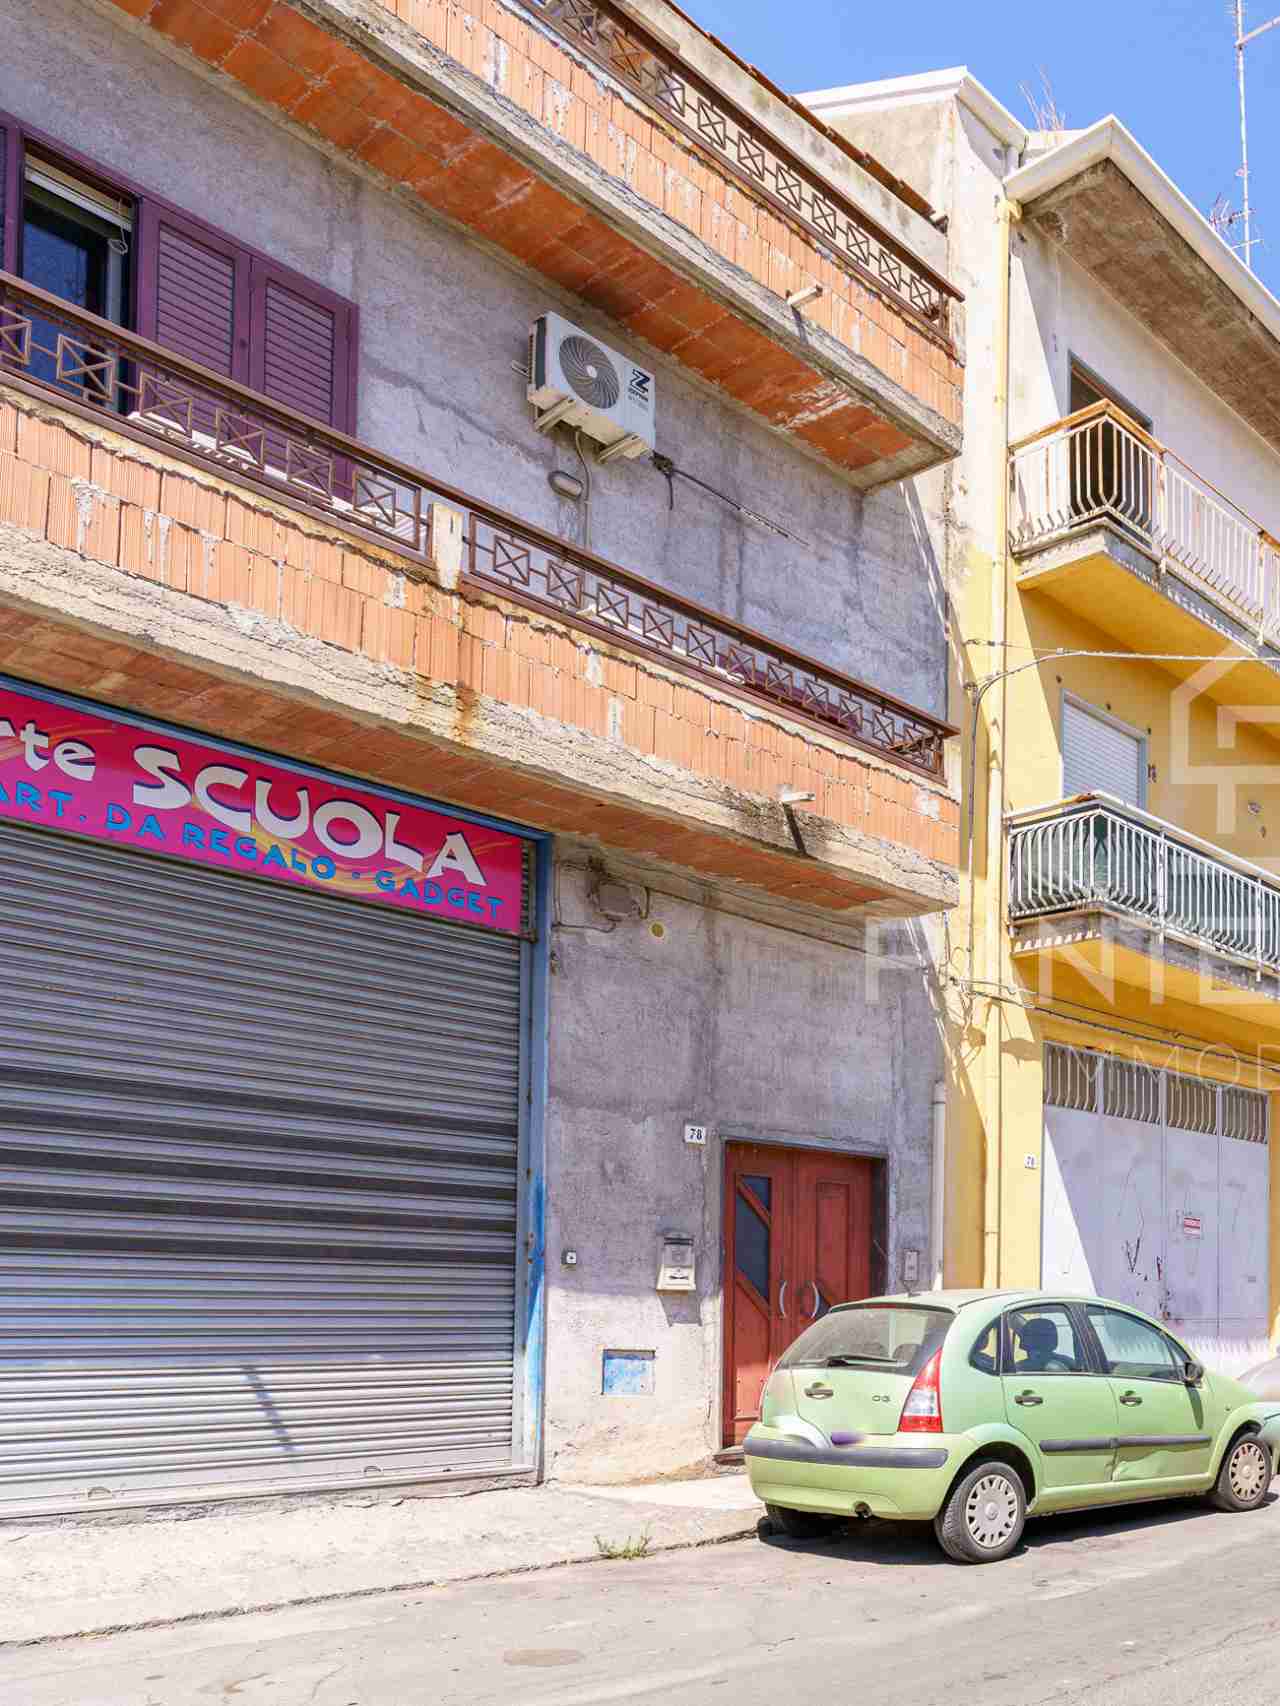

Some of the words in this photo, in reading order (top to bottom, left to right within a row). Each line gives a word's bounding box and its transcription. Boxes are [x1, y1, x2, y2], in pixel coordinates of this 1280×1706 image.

[0, 718, 97, 781] te
[132, 746, 487, 886] SCUOLA
[105, 802, 166, 841] DA
[182, 822, 337, 880] REGALO
[375, 870, 504, 920] GADGET
[690, 1127, 703, 1141] 78
